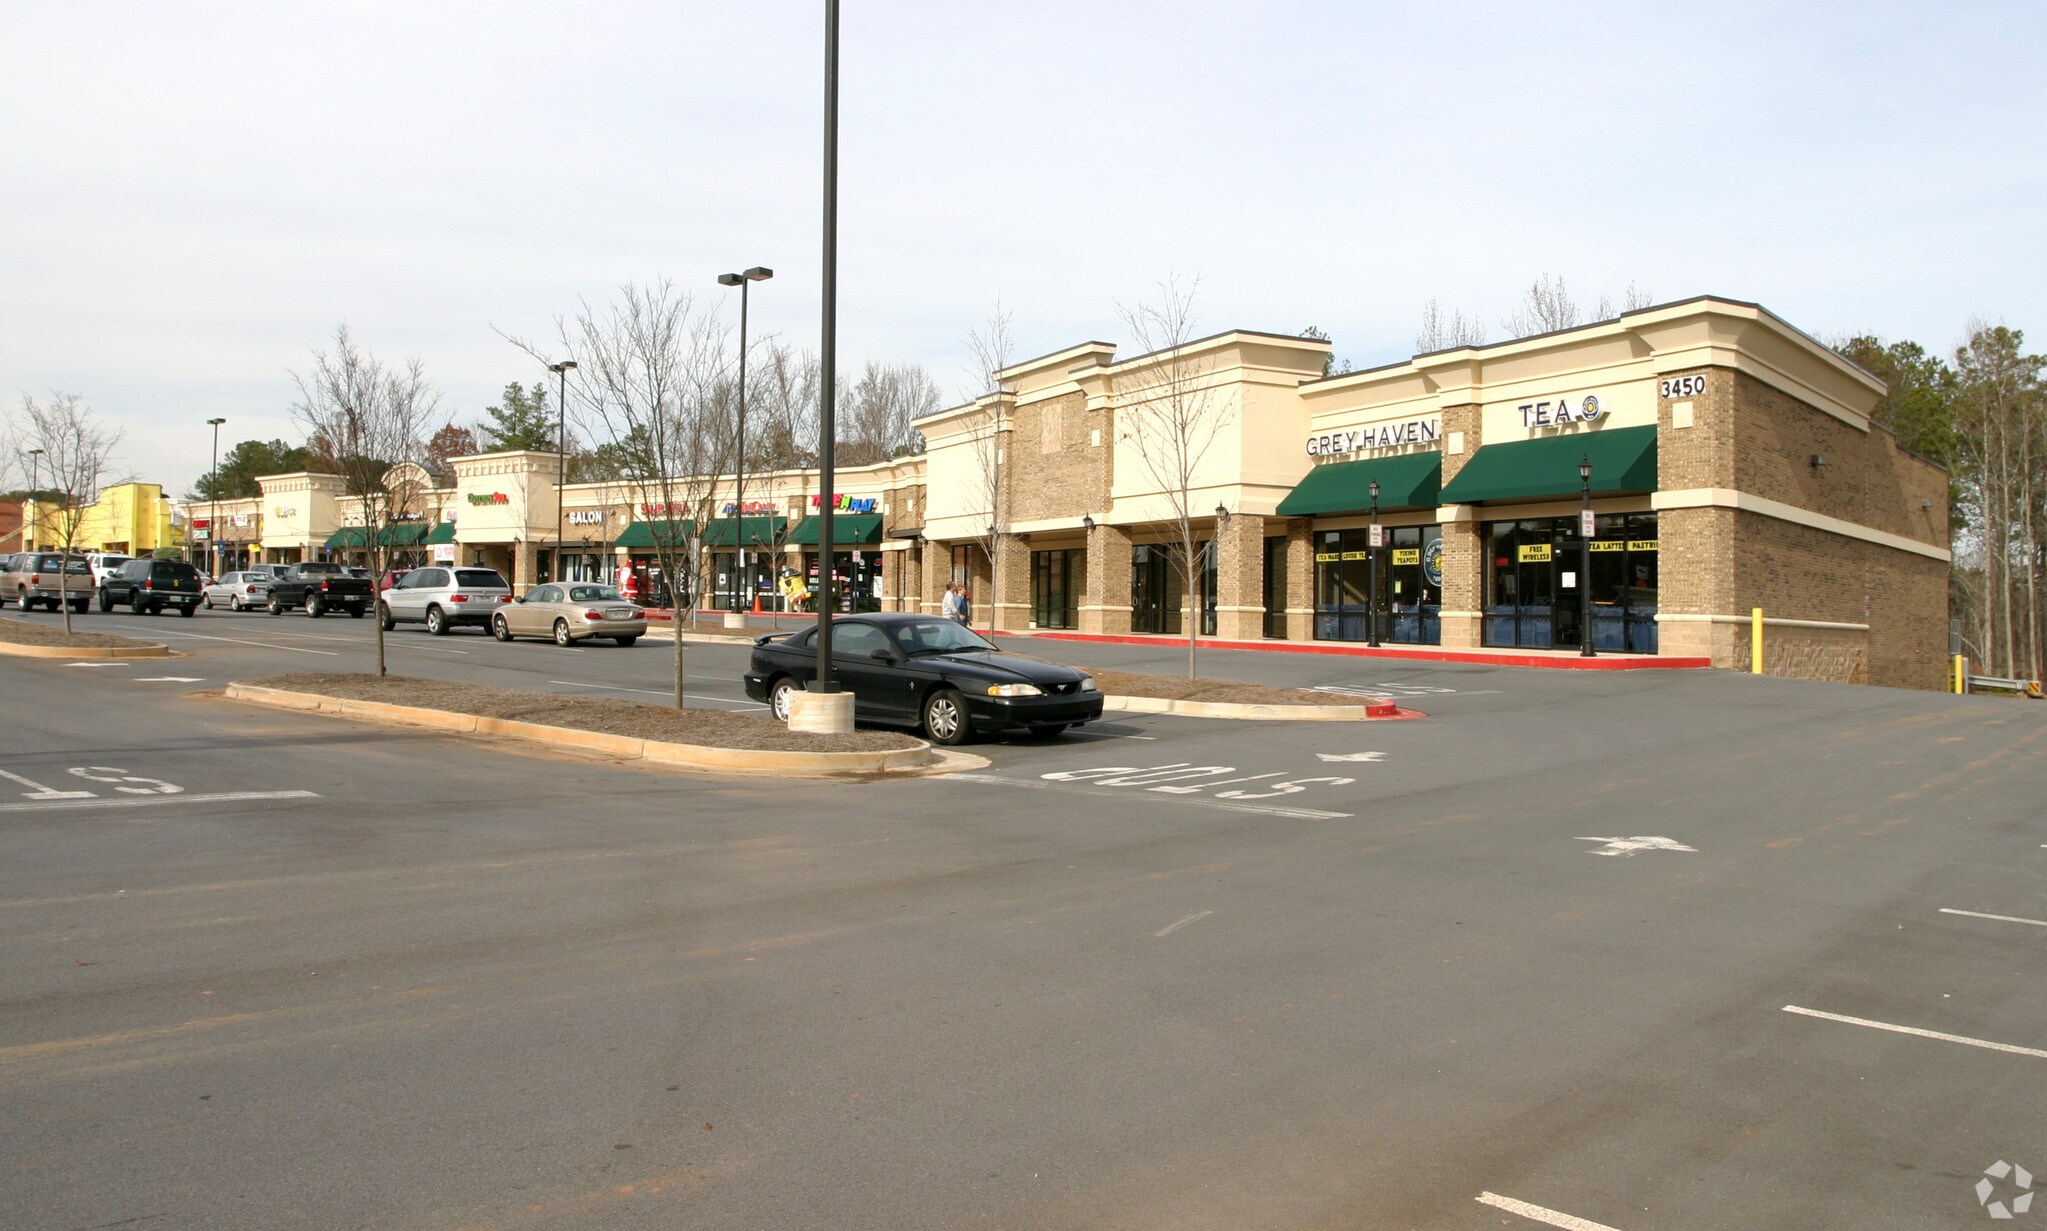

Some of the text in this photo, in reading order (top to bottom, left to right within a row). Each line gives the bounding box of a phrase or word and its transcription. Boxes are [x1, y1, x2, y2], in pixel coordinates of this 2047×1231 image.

[1662, 376, 1705, 398] 3450
[1518, 400, 1571, 427] TEA
[1306, 419, 1438, 456] GREY HAVEN
[569, 511, 602, 524] SALON
[850, 499, 876, 512] PLAY
[1522, 553, 1550, 561] WIRELESS
[0, 766, 185, 800] ST
[1041, 763, 1356, 799] STOP
